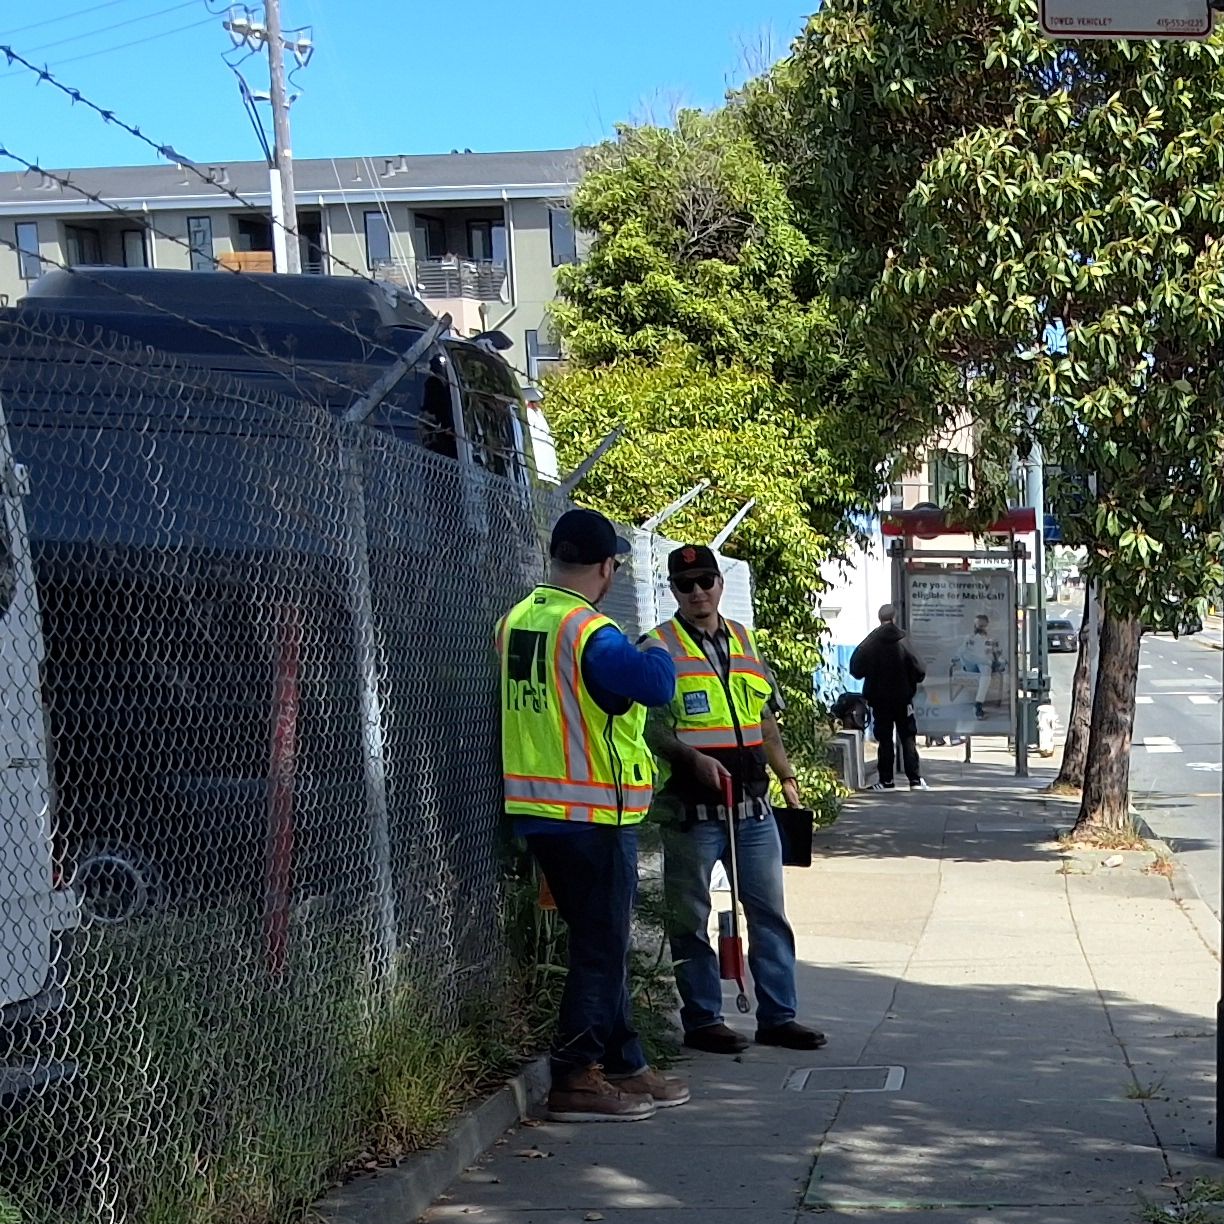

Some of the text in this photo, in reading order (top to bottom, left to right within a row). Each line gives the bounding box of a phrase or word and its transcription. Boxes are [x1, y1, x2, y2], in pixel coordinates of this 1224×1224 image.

[1050, 16, 1074, 26] TOWED
[1077, 17, 1112, 26] VEHICLE?
[912, 580, 927, 589] Are
[948, 580, 990, 590] currently
[912, 592, 1005, 601] eligible for Medi-Cal?
